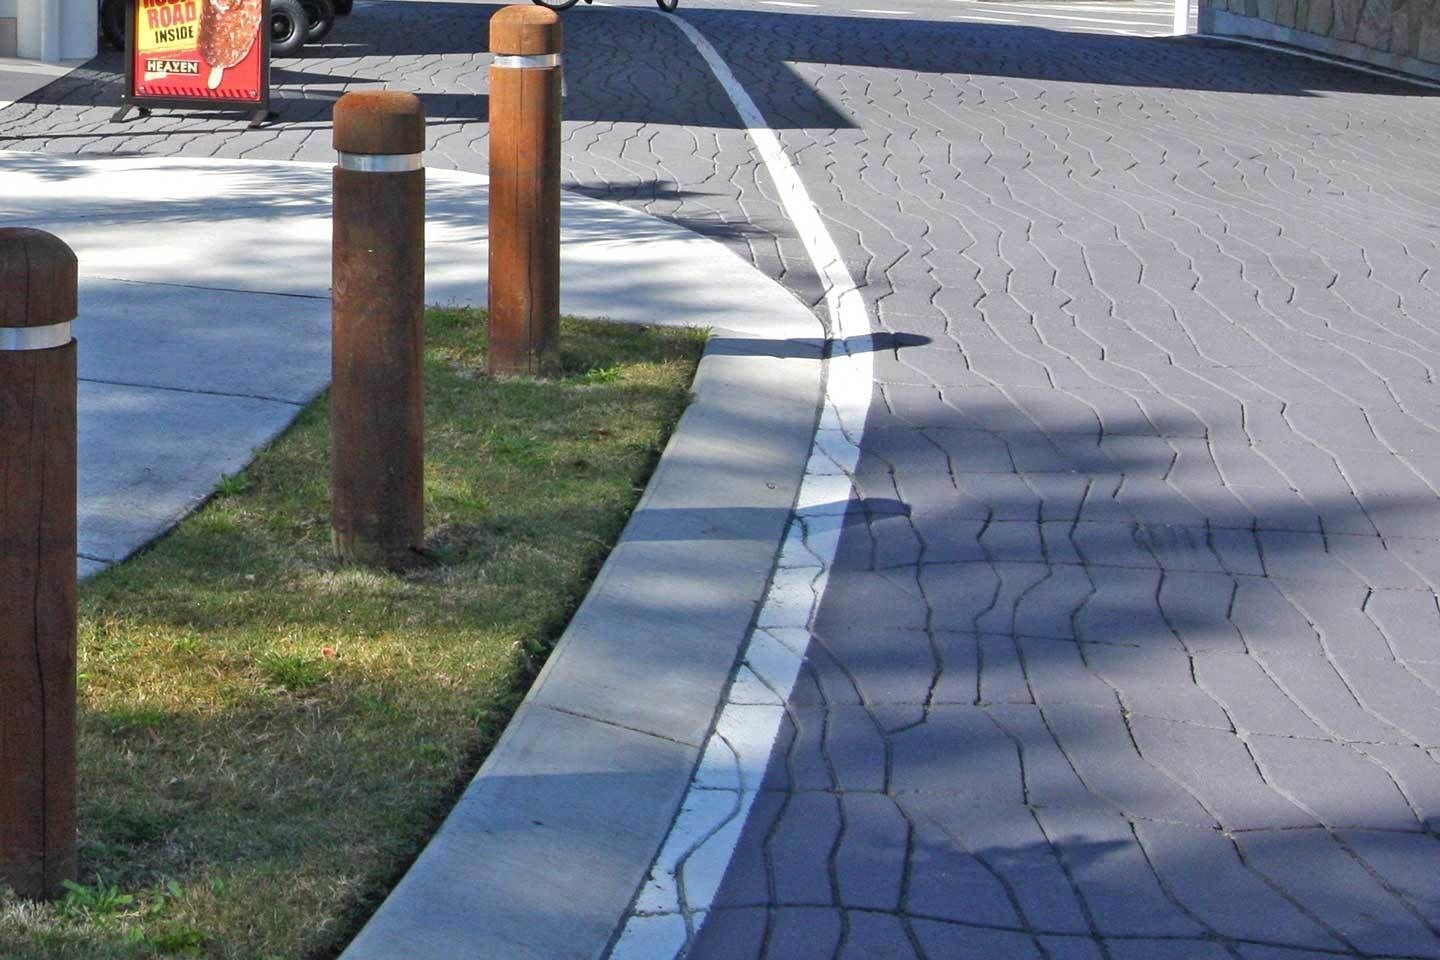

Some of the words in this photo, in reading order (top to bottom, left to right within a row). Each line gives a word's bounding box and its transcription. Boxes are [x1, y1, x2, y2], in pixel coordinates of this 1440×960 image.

[148, 1, 197, 29] ROAD
[155, 26, 194, 43] INSIDE
[147, 60, 198, 74] HEAVEN
